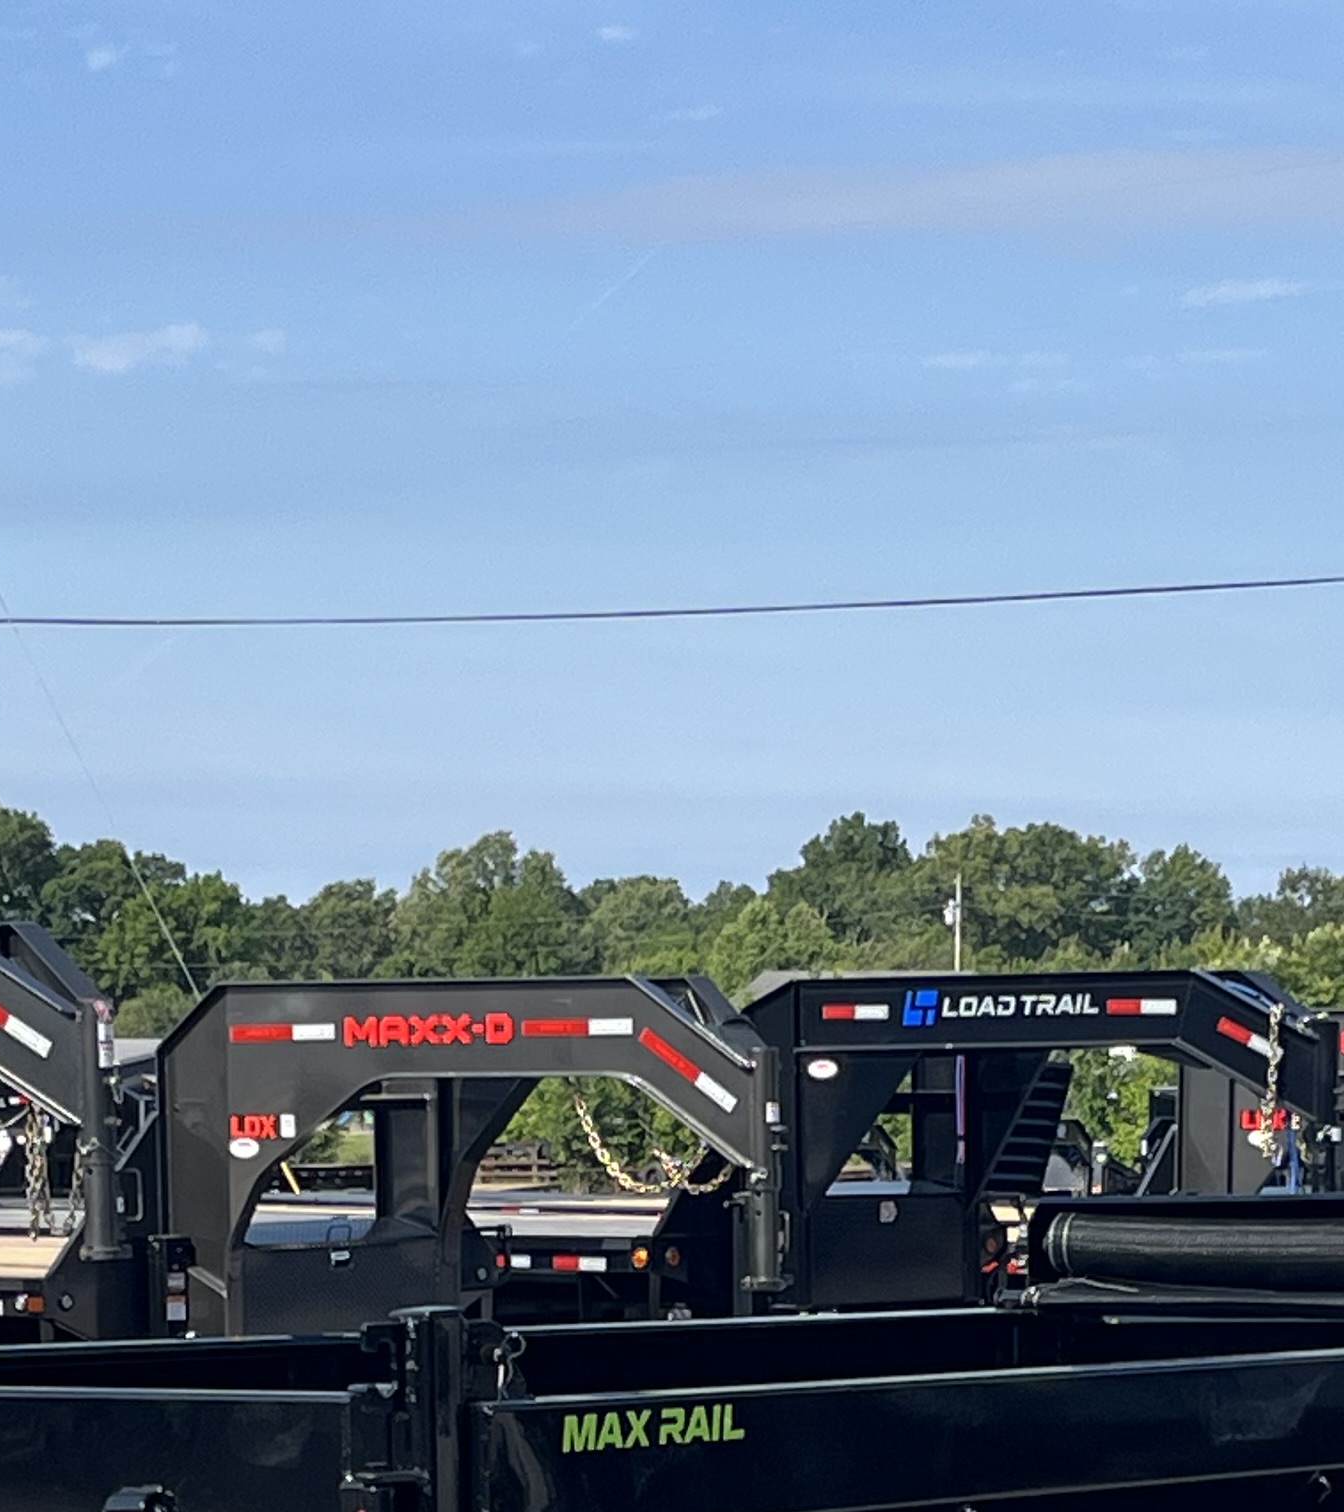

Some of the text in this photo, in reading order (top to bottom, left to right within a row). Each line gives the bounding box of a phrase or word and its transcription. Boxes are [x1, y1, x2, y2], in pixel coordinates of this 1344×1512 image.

[941, 993, 1100, 1018] LOAD TRAIL
[342, 1011, 514, 1047] MAXX-D
[229, 1113, 277, 1140] LDX
[562, 1403, 746, 1454] MAX RAIL
